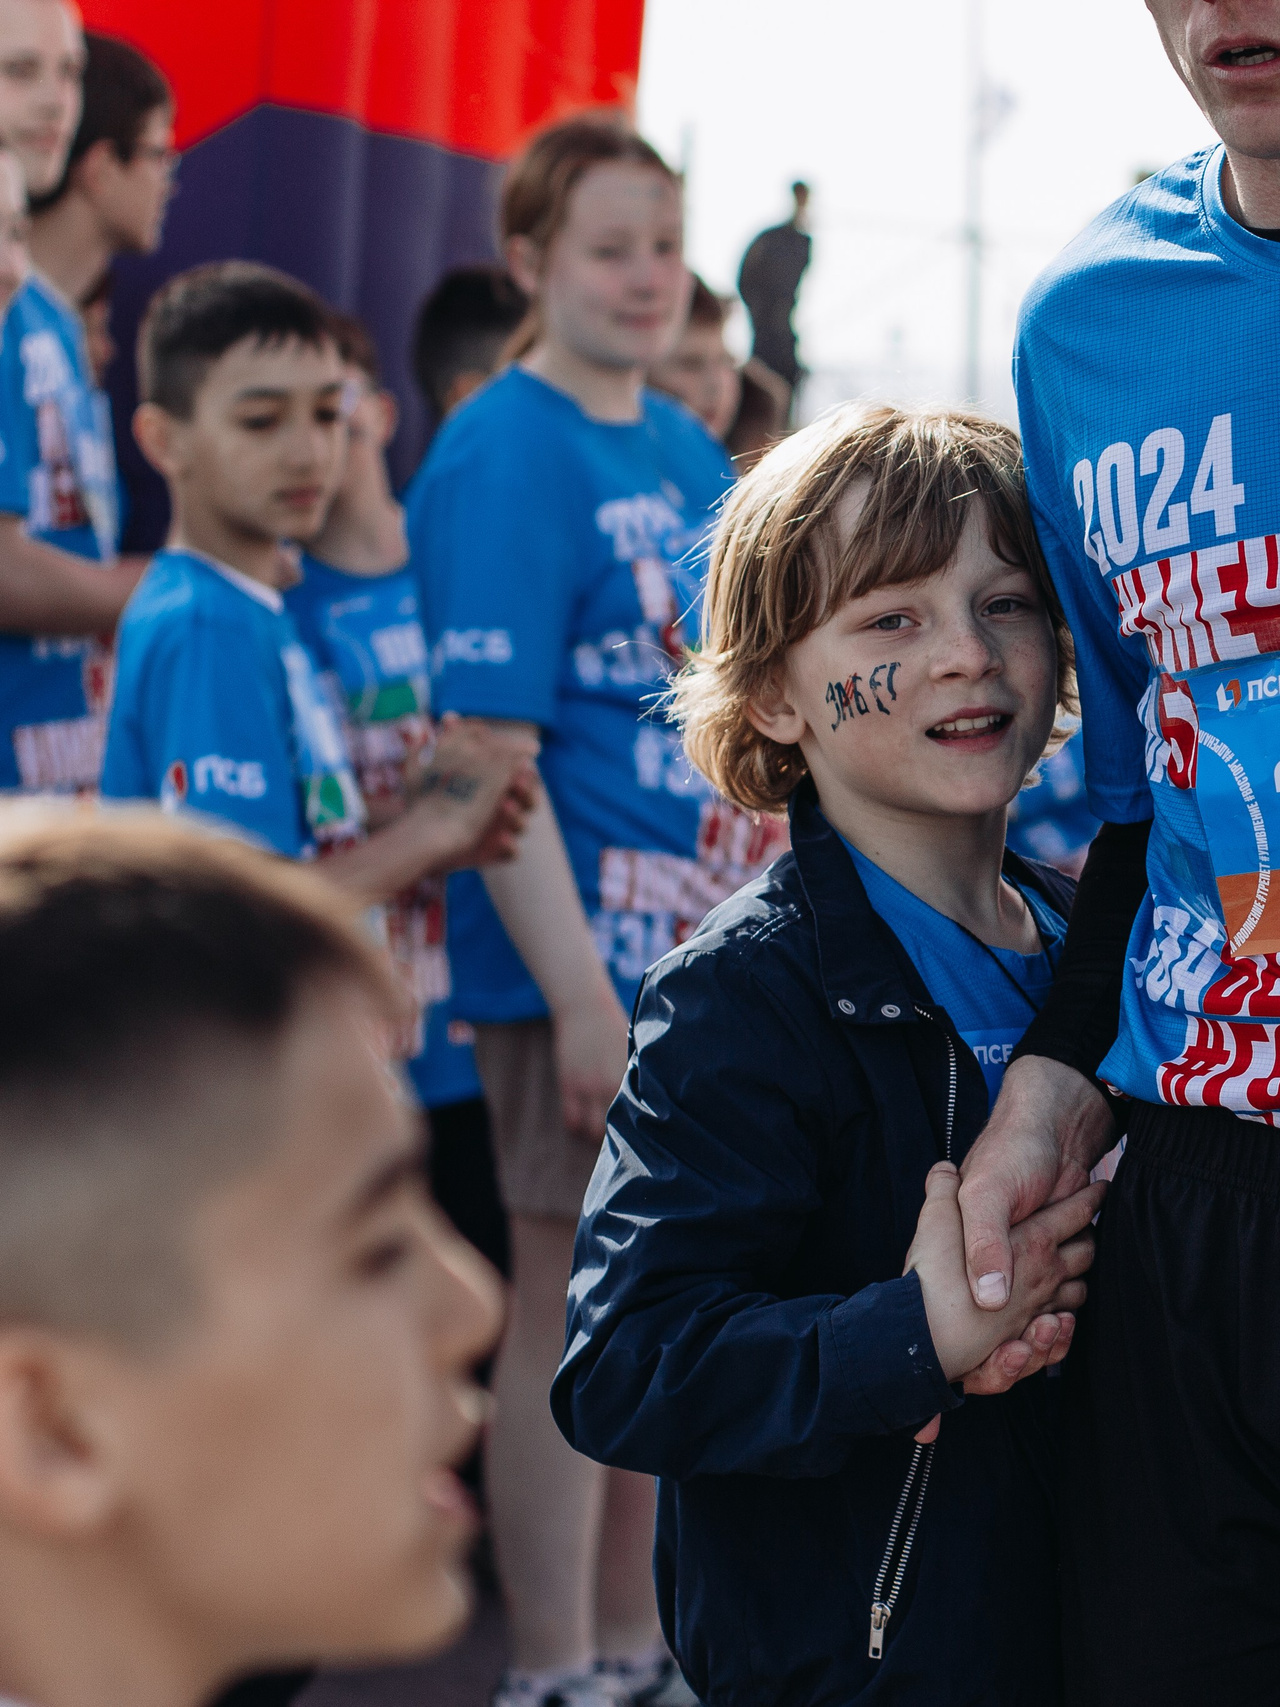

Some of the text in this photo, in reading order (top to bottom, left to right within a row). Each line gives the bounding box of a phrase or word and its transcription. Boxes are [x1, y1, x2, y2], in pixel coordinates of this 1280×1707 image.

[1073, 413, 1245, 577] 2024
[1227, 758, 1255, 803] #ВОСТОРГ
[1247, 801, 1270, 862] #УДИВЛЕНИЕ
[1255, 862, 1271, 904] #ТРЕПЕТ
[1233, 900, 1265, 948] #ВОЛНЕНИЕ
